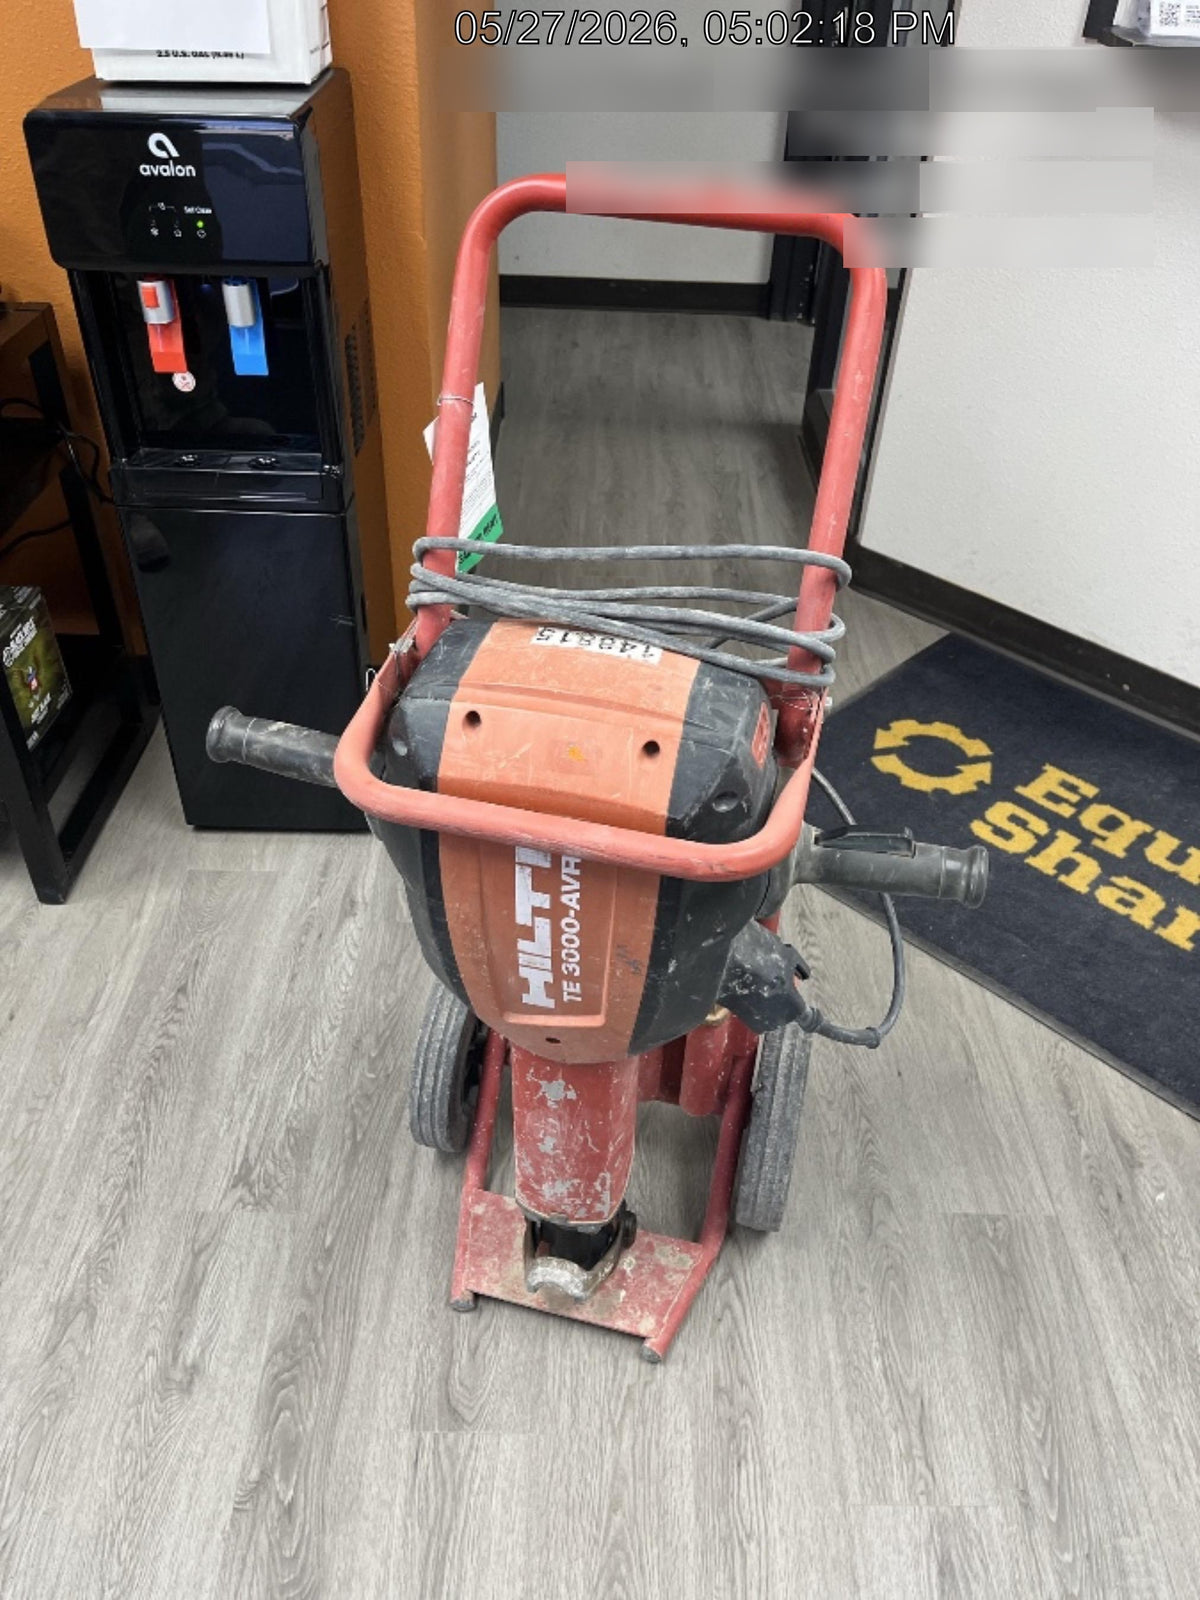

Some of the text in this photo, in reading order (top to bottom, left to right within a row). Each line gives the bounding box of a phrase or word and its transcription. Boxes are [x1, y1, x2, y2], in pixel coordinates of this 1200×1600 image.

[139, 160, 196, 177] avalon
[515, 845, 555, 1008] HILTI
[560, 855, 582, 1003] TE 3000-AVR
[970, 801, 1200, 951] Shar
